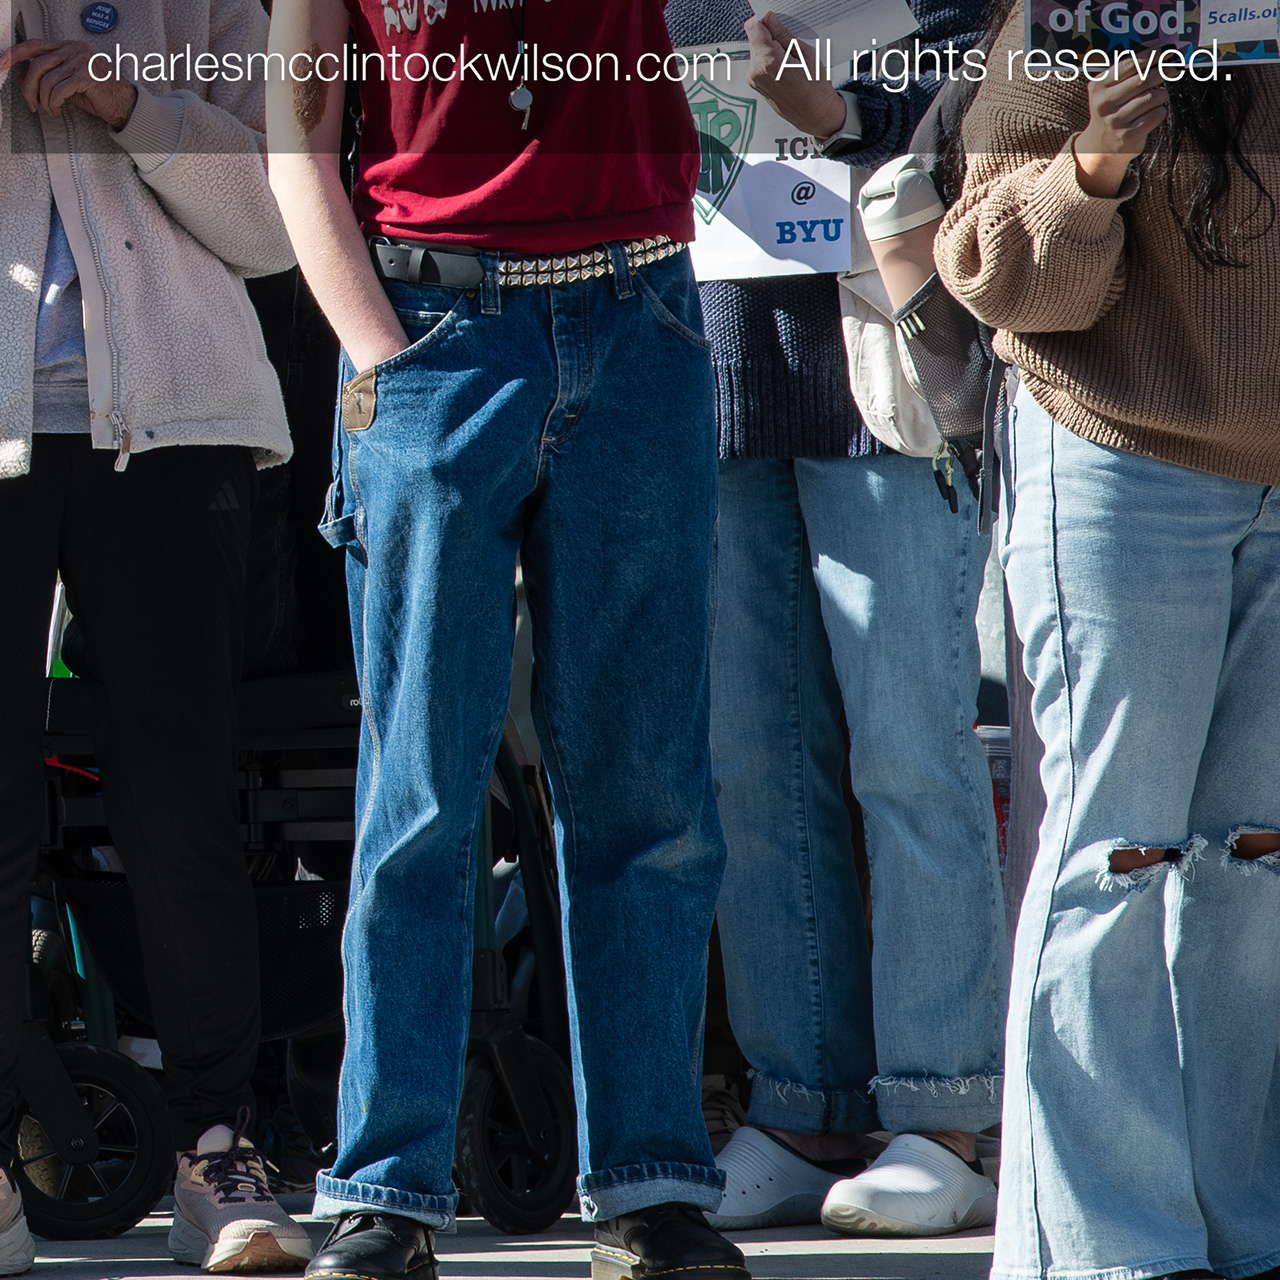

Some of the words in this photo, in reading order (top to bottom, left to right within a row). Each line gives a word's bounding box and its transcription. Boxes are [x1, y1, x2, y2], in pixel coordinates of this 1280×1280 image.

[1048, 0, 1092, 33] of
[1100, 1, 1194, 36] God.
[775, 136, 824, 162] IC
[791, 181, 816, 205] @
[775, 218, 844, 244] BYU
